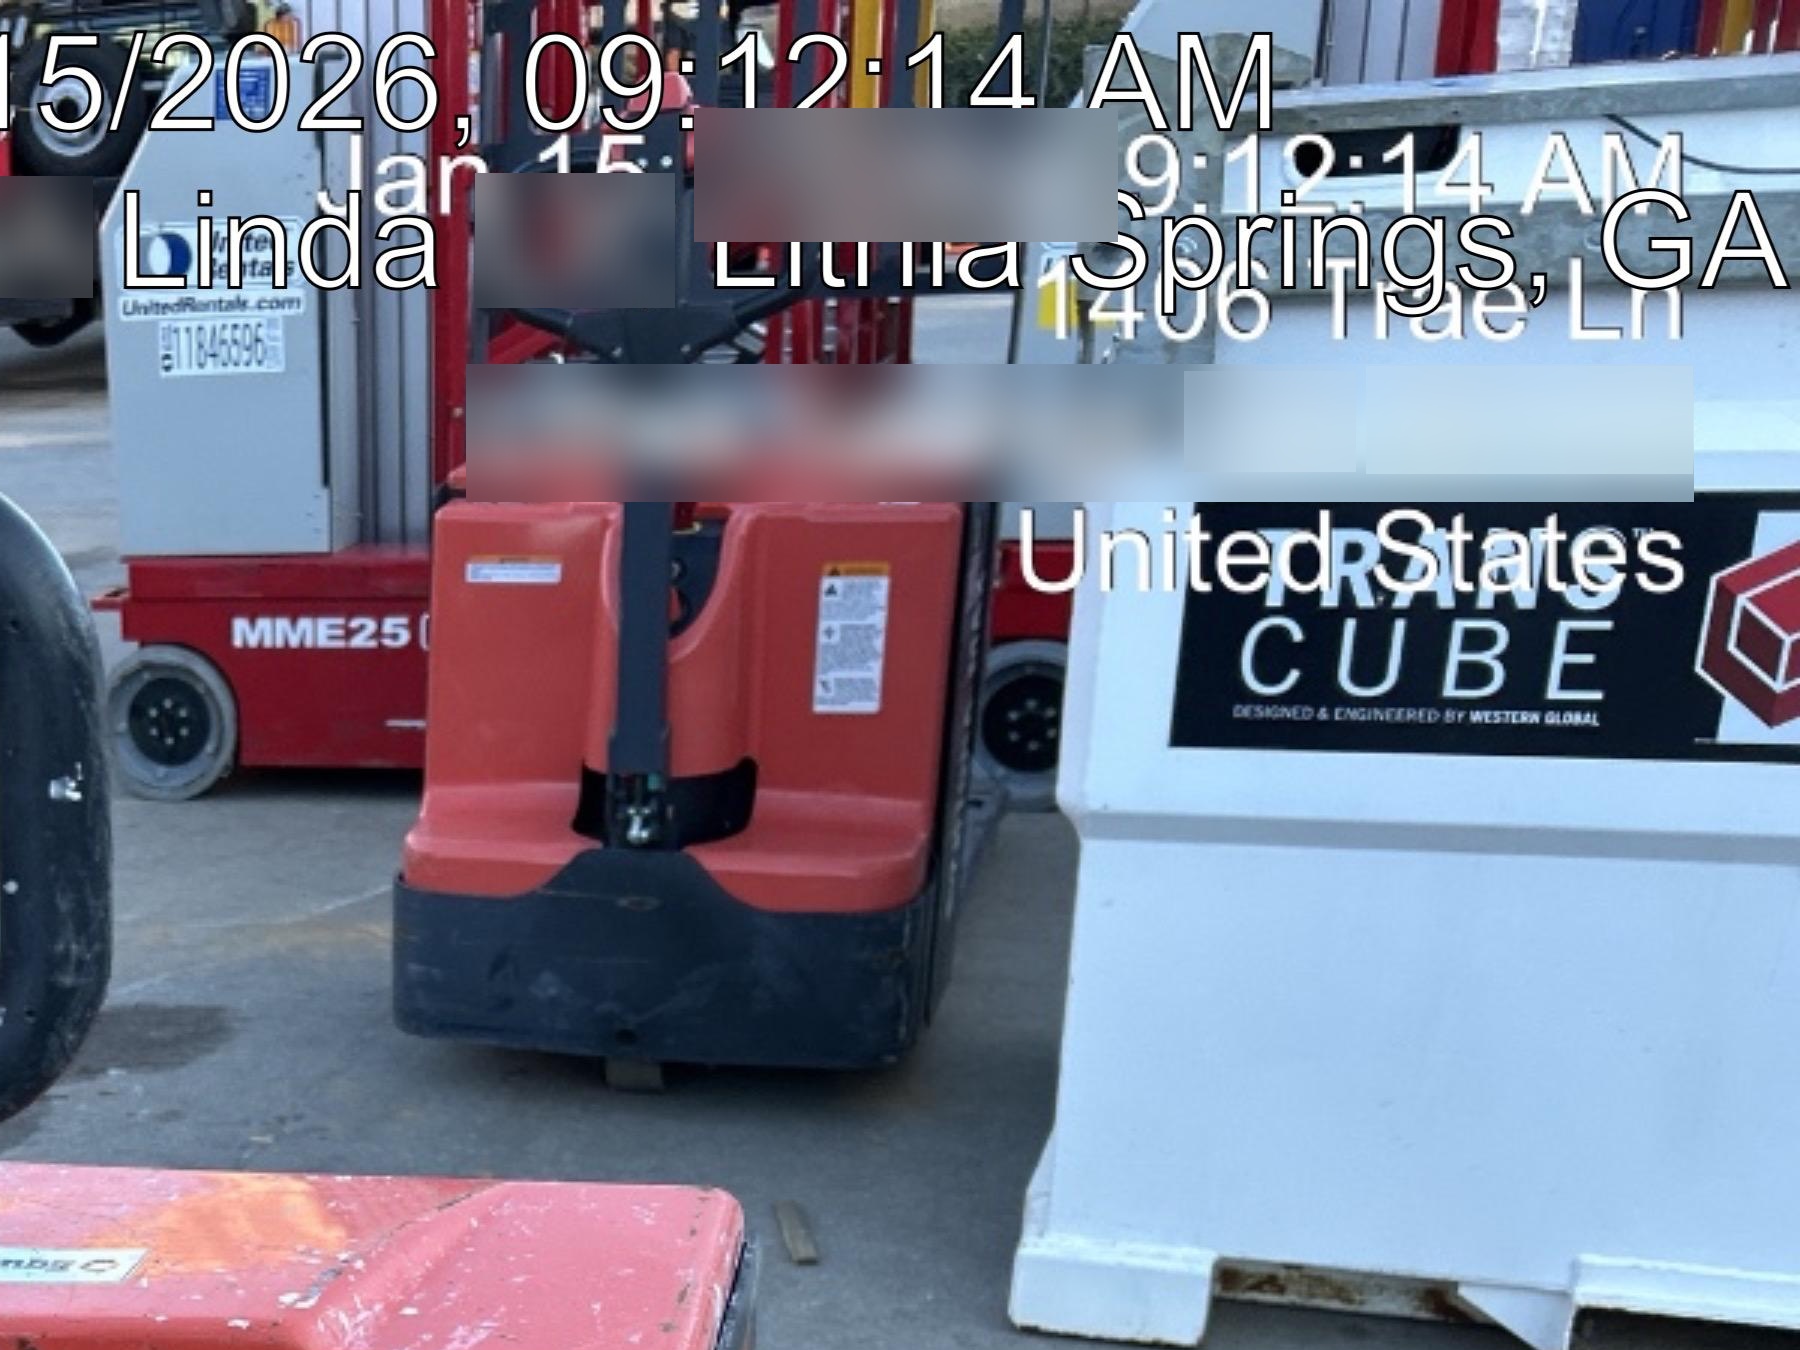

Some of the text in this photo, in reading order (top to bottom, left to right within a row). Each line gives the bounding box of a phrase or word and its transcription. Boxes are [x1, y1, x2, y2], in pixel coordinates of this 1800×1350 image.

[231, 616, 411, 649] MME25
[1239, 615, 1614, 701] CUBE
[1232, 703, 1601, 727] DESIGNED & ENGINEERED BY WESTERN GLOBAL
